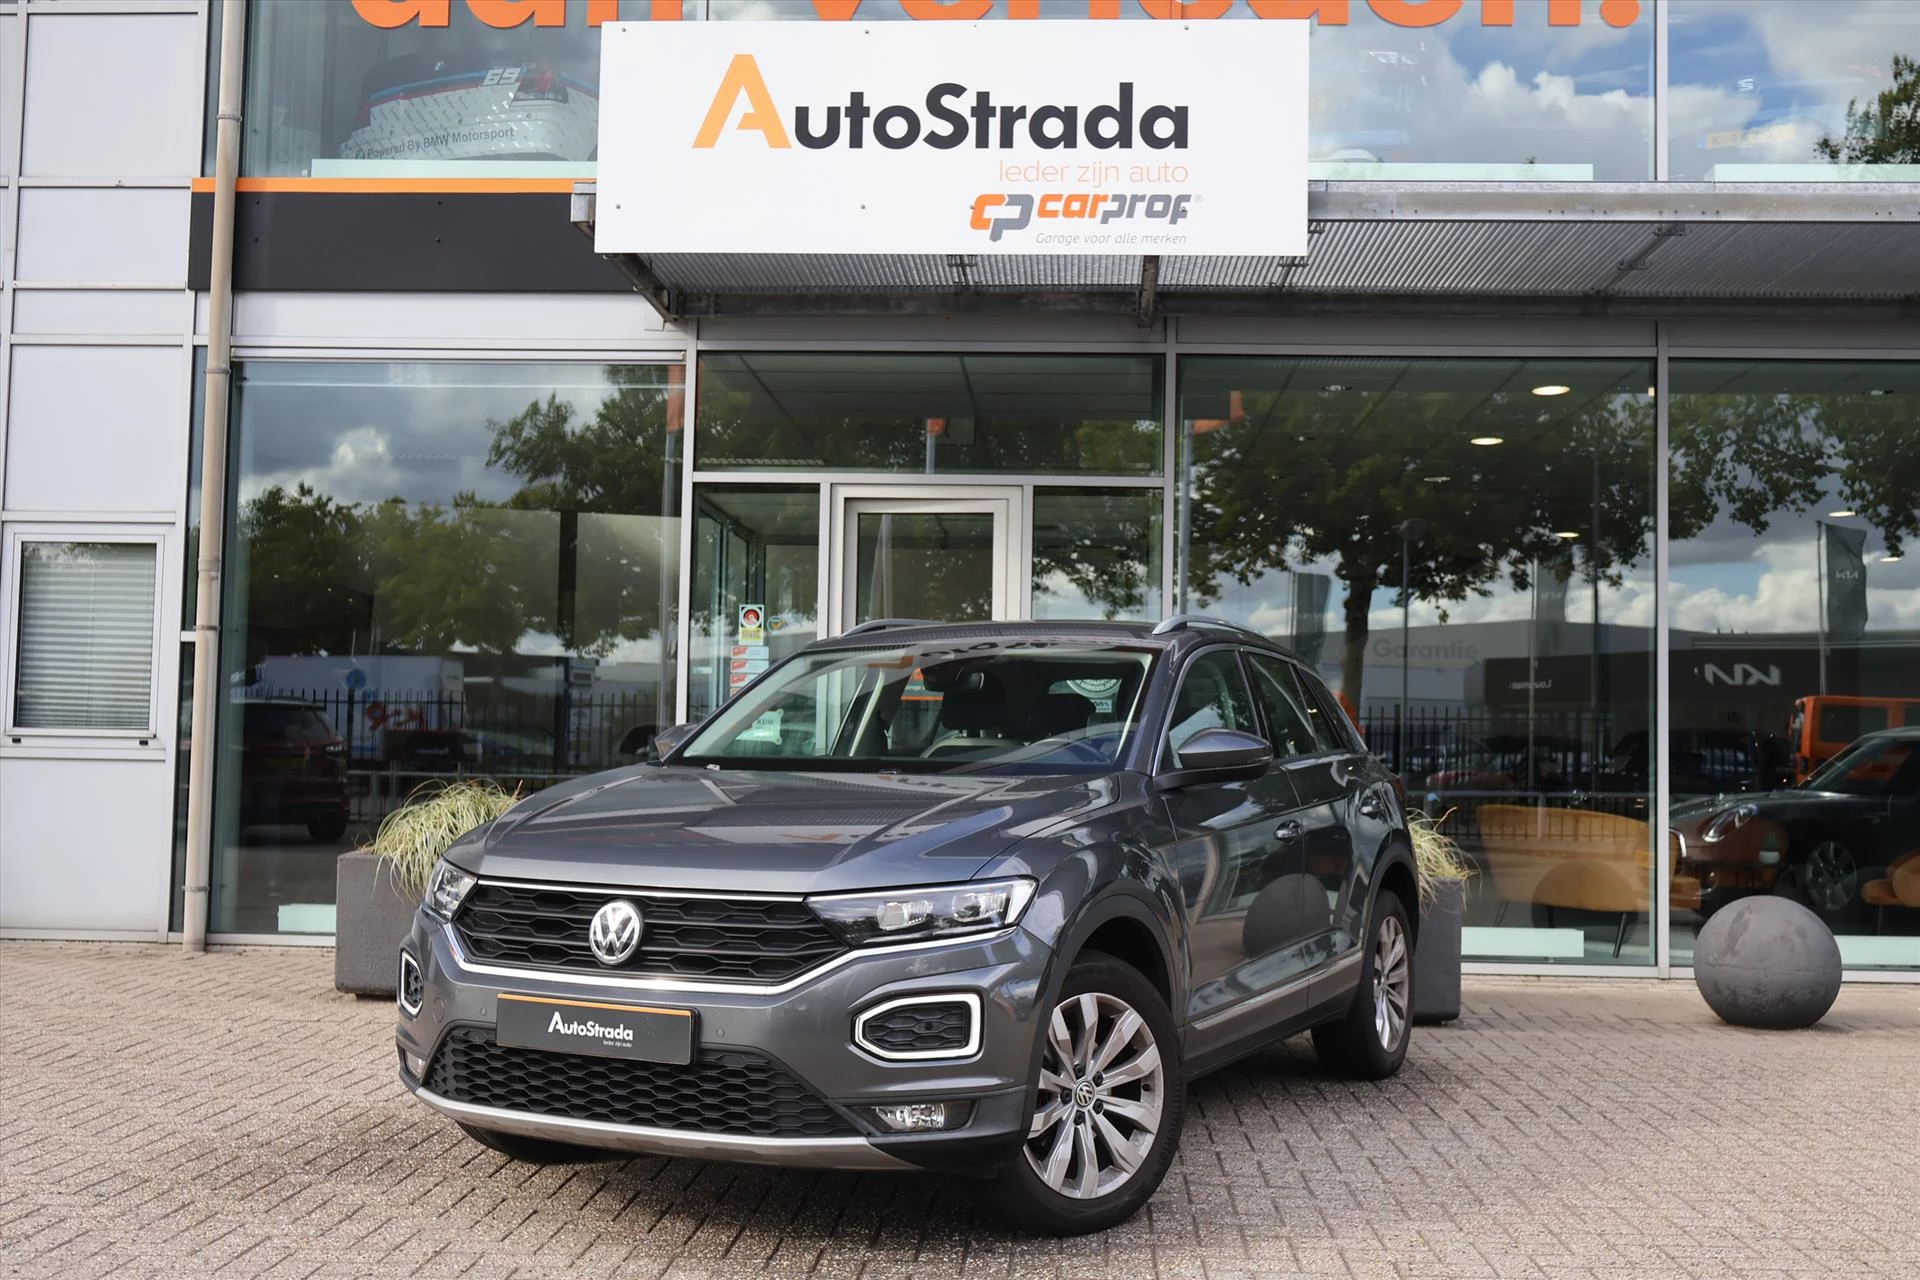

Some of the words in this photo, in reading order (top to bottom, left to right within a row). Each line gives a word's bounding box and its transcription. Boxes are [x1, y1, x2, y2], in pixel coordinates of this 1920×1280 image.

[483, 67, 522, 87] 69
[691, 53, 1189, 150] AutoStrada
[367, 141, 405, 159] Powered
[408, 140, 421, 153] By
[423, 134, 450, 149] BMW
[452, 127, 514, 143] Motorsport
[999, 161, 1069, 183] Ieder
[1077, 162, 1120, 187] zijn
[1129, 162, 1189, 183] auto
[1036, 232, 1081, 247] Garage
[1084, 234, 1112, 245] voor
[1114, 232, 1138, 245] alle
[1140, 232, 1187, 245] merken
[1372, 638, 1478, 660] Garantie
[548, 1011, 634, 1041] AutoStrada
